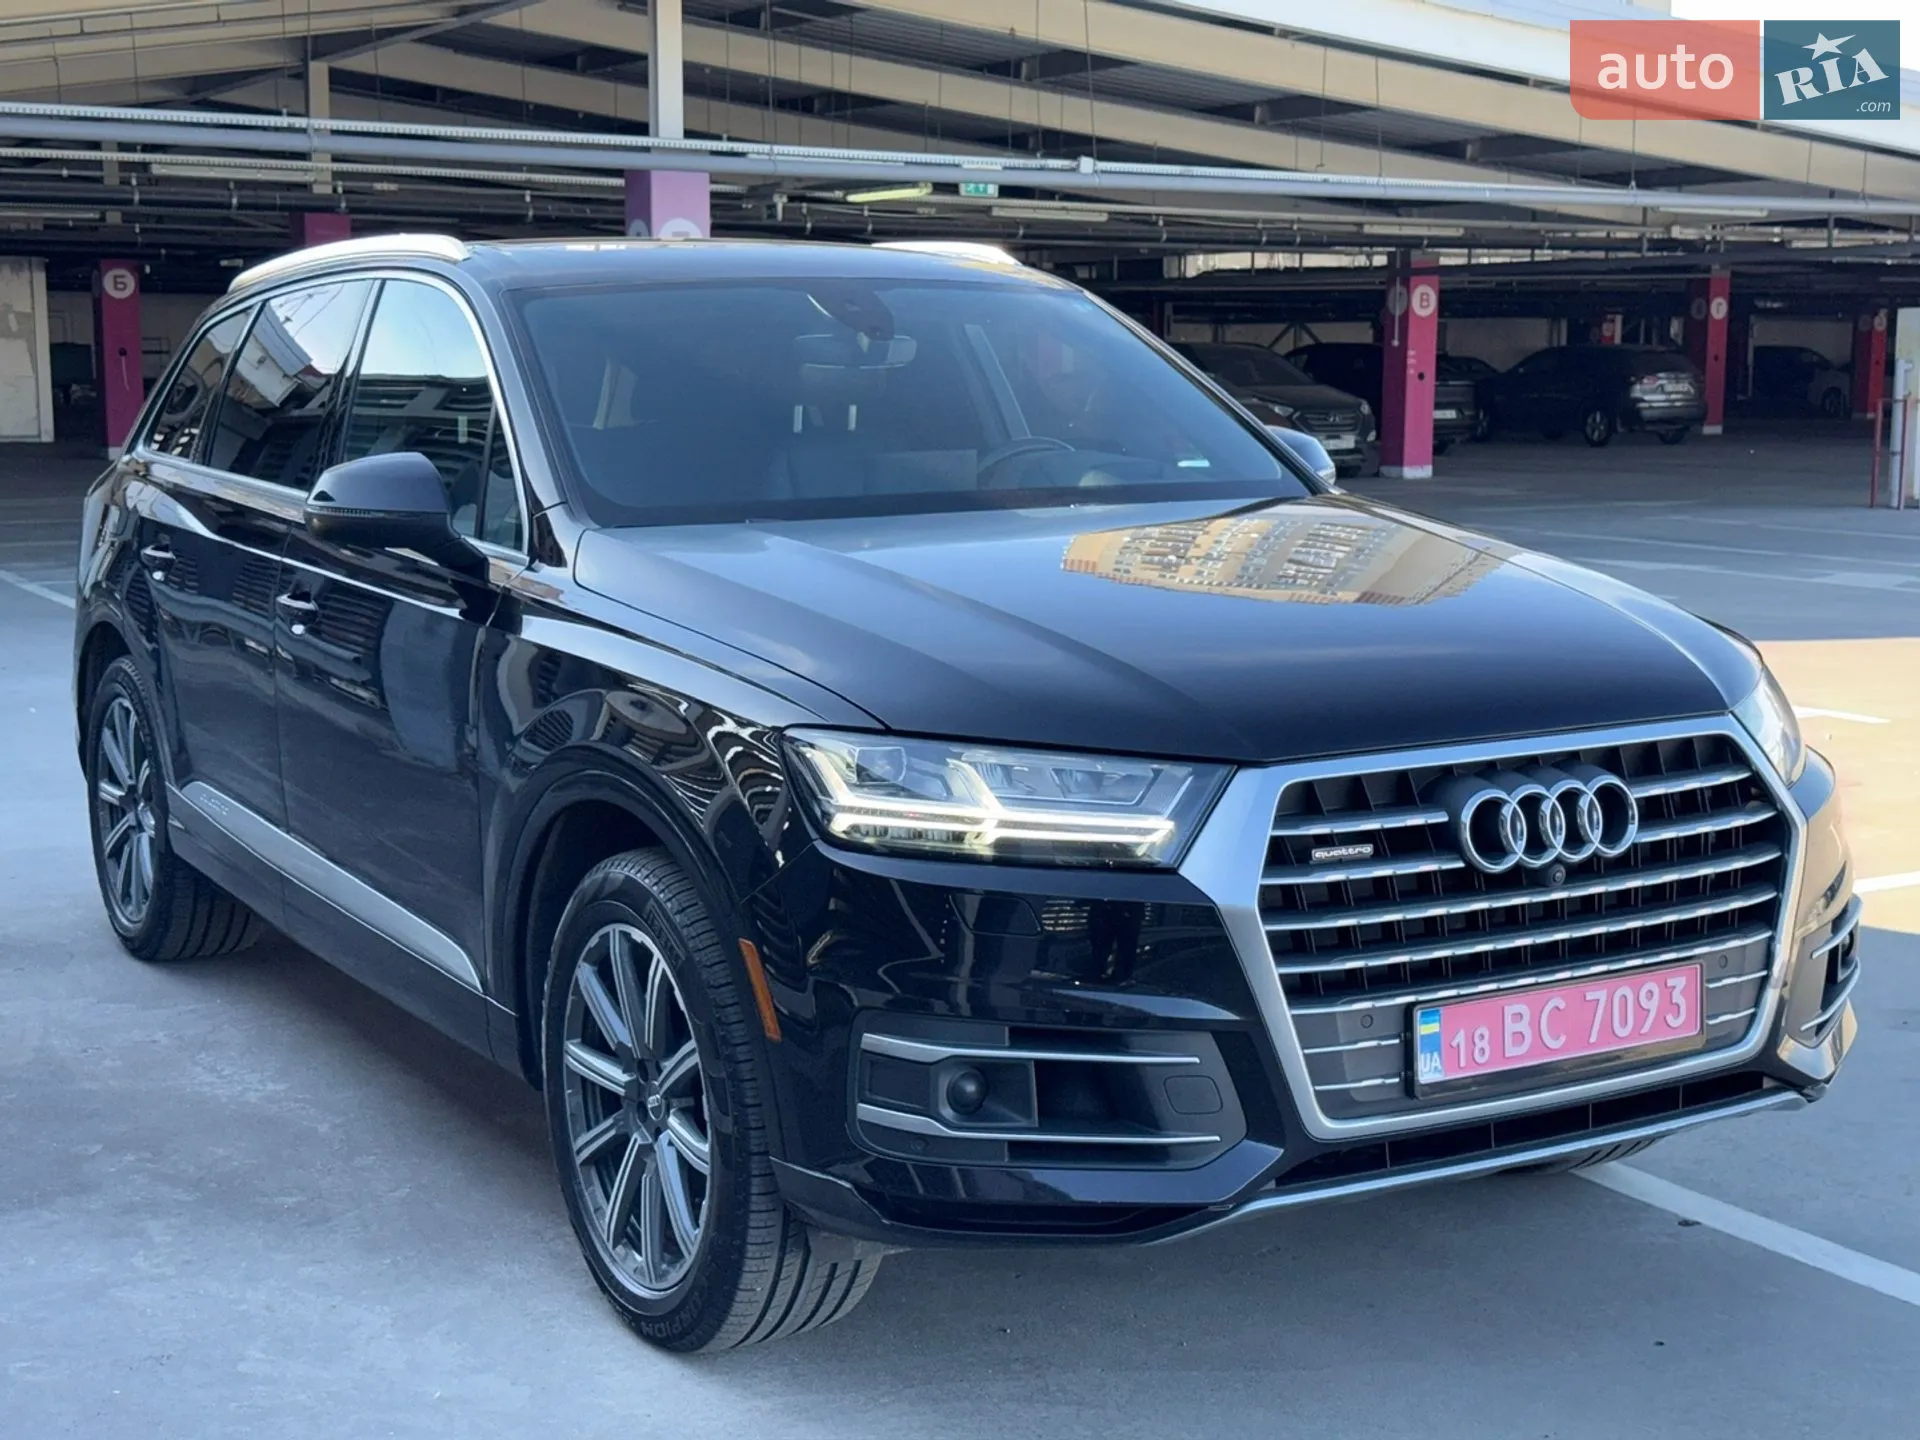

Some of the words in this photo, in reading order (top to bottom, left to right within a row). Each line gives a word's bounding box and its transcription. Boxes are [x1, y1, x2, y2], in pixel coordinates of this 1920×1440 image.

[113, 275, 128, 291] Б
[1314, 846, 1371, 859] quattro
[1450, 1027, 1490, 1068] 18
[1503, 997, 1566, 1057] BC
[1585, 976, 1687, 1044] 7093
[1421, 1053, 1442, 1073] UA
